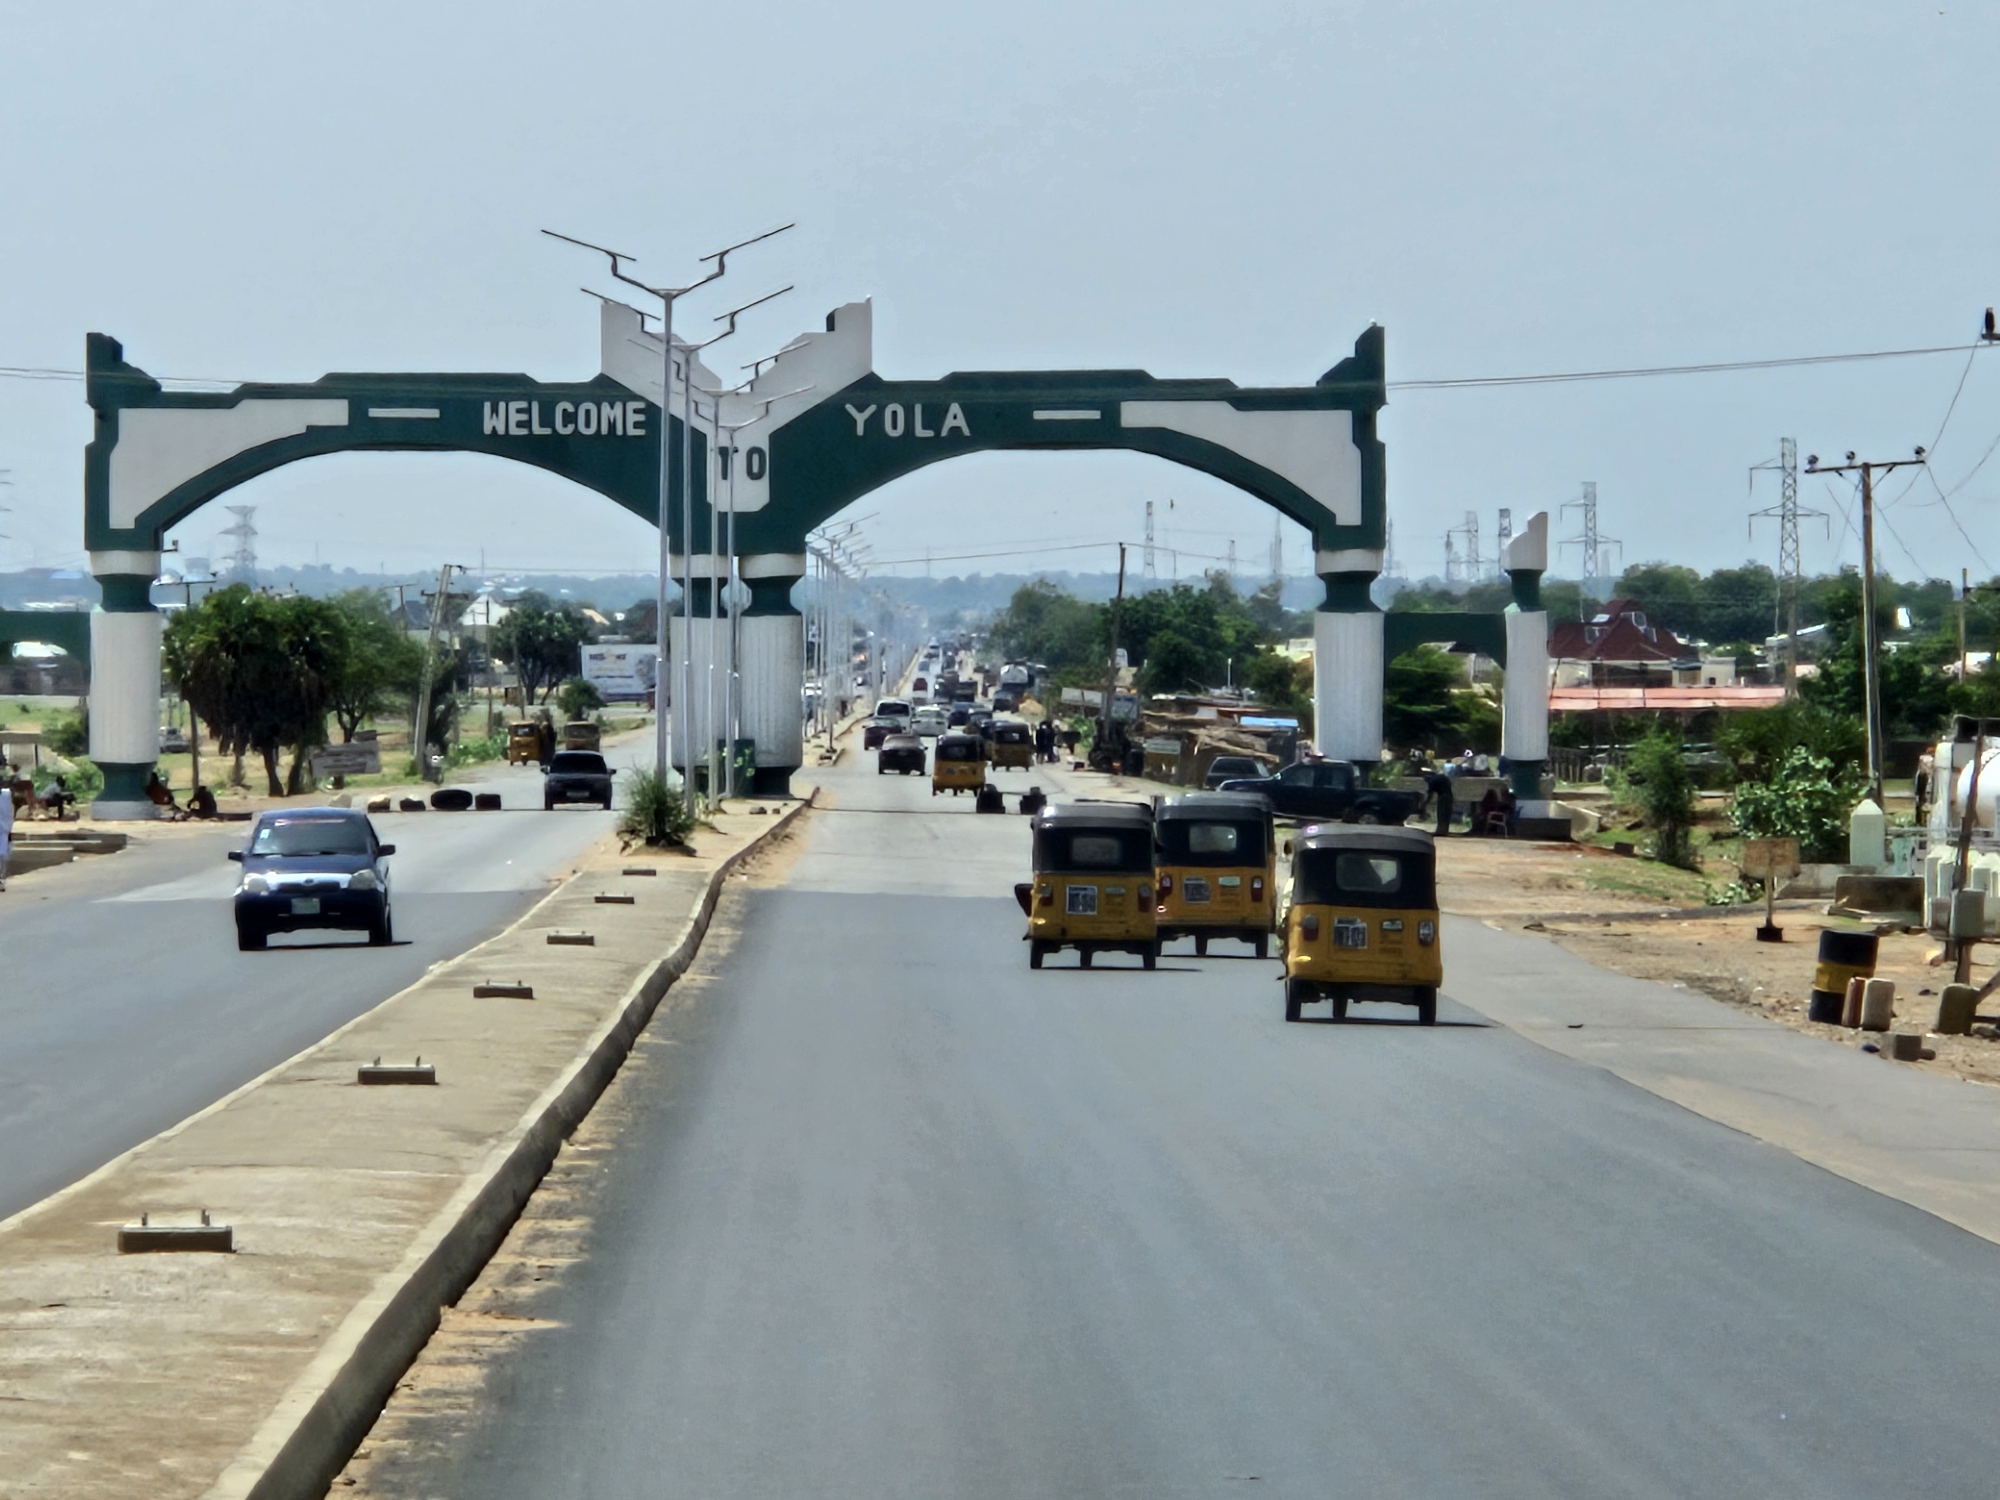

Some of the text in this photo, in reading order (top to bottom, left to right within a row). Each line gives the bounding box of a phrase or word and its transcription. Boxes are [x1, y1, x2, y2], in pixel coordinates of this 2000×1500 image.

[483, 401, 971, 481] WELCOME TO YOLA
